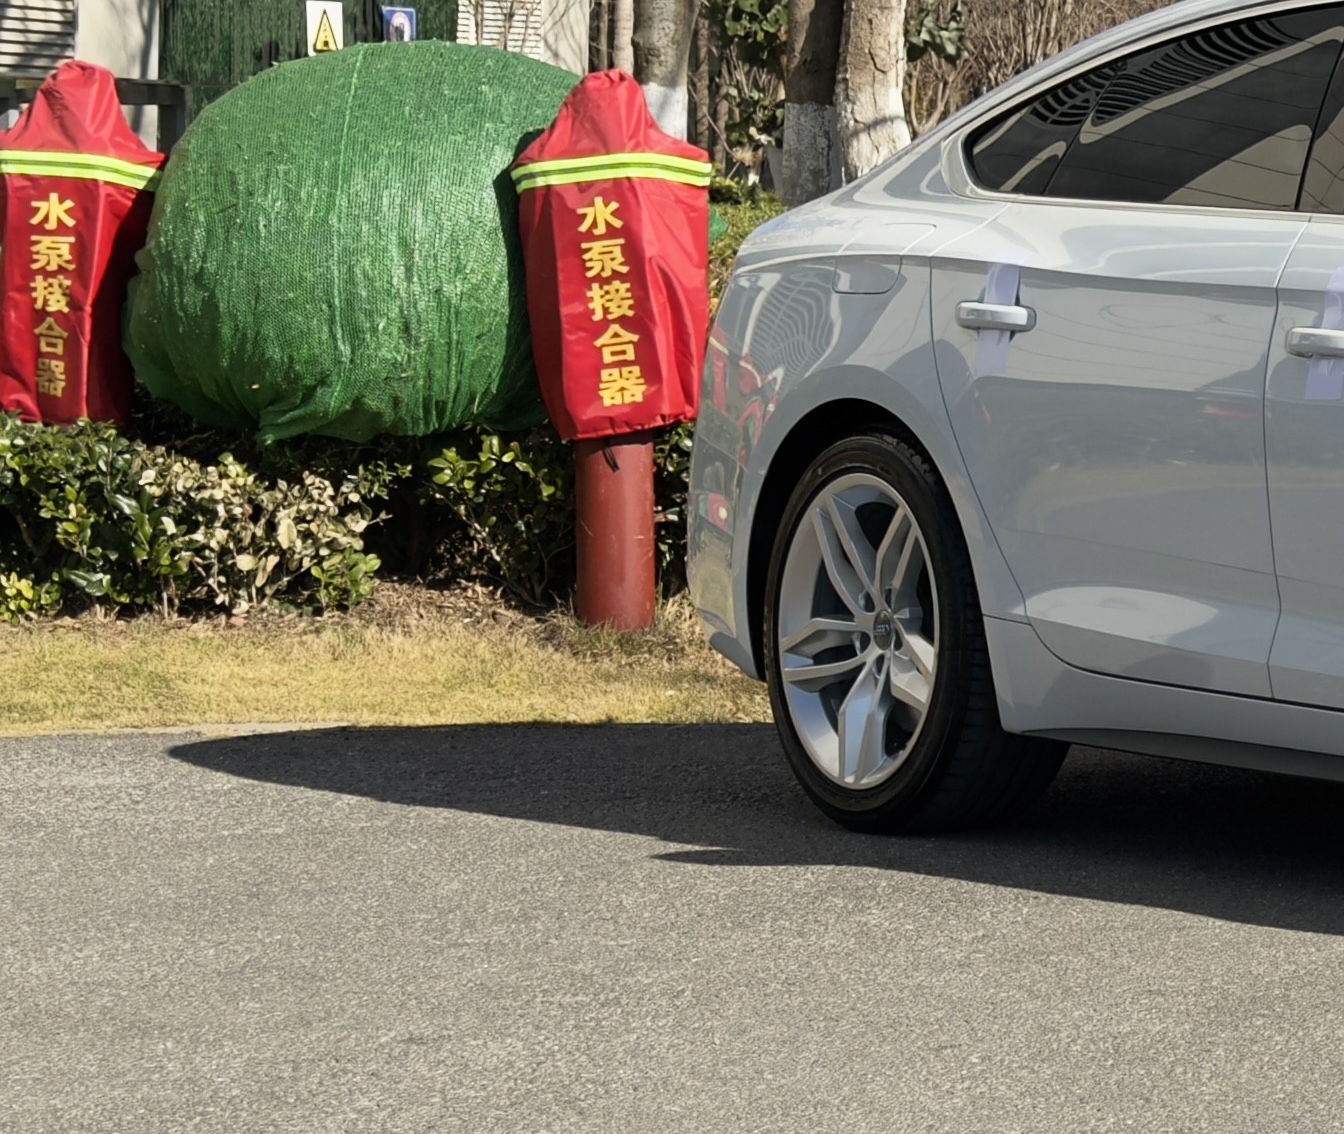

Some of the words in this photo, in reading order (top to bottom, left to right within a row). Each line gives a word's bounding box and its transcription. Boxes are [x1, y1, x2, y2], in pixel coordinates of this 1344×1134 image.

[29, 192, 77, 398] 水泵接合器
[576, 196, 647, 407] 水泵接合器
